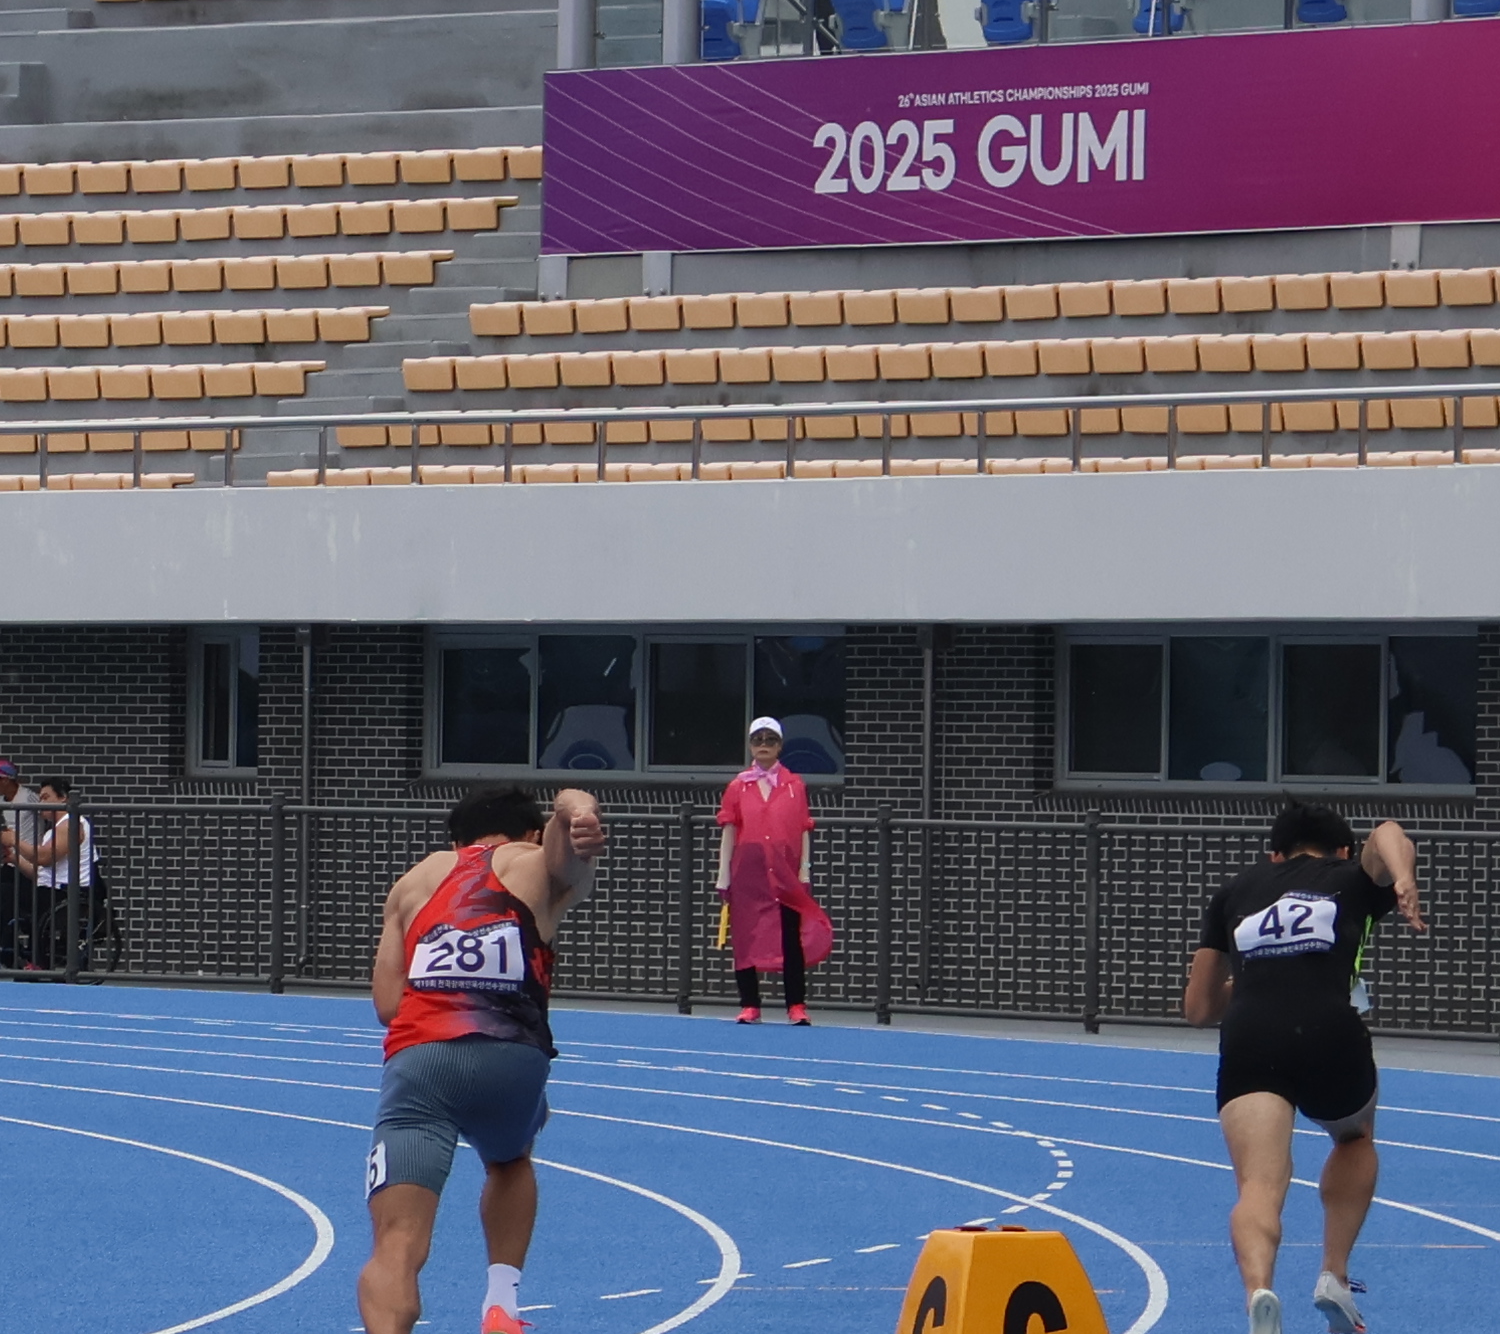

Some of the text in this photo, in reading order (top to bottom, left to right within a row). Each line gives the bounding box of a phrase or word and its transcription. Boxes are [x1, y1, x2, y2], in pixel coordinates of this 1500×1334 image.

[914, 93, 946, 107] ASIAN
[947, 88, 1004, 105] ATHLETICS
[1005, 84, 1093, 102] CHAMPIONSHIPS
[1095, 83, 1120, 98] 2025
[1121, 81, 1150, 96] GUMI
[813, 109, 1146, 194] 2025 GUMI
[1258, 903, 1314, 940] 42
[425, 934, 508, 974] 281
